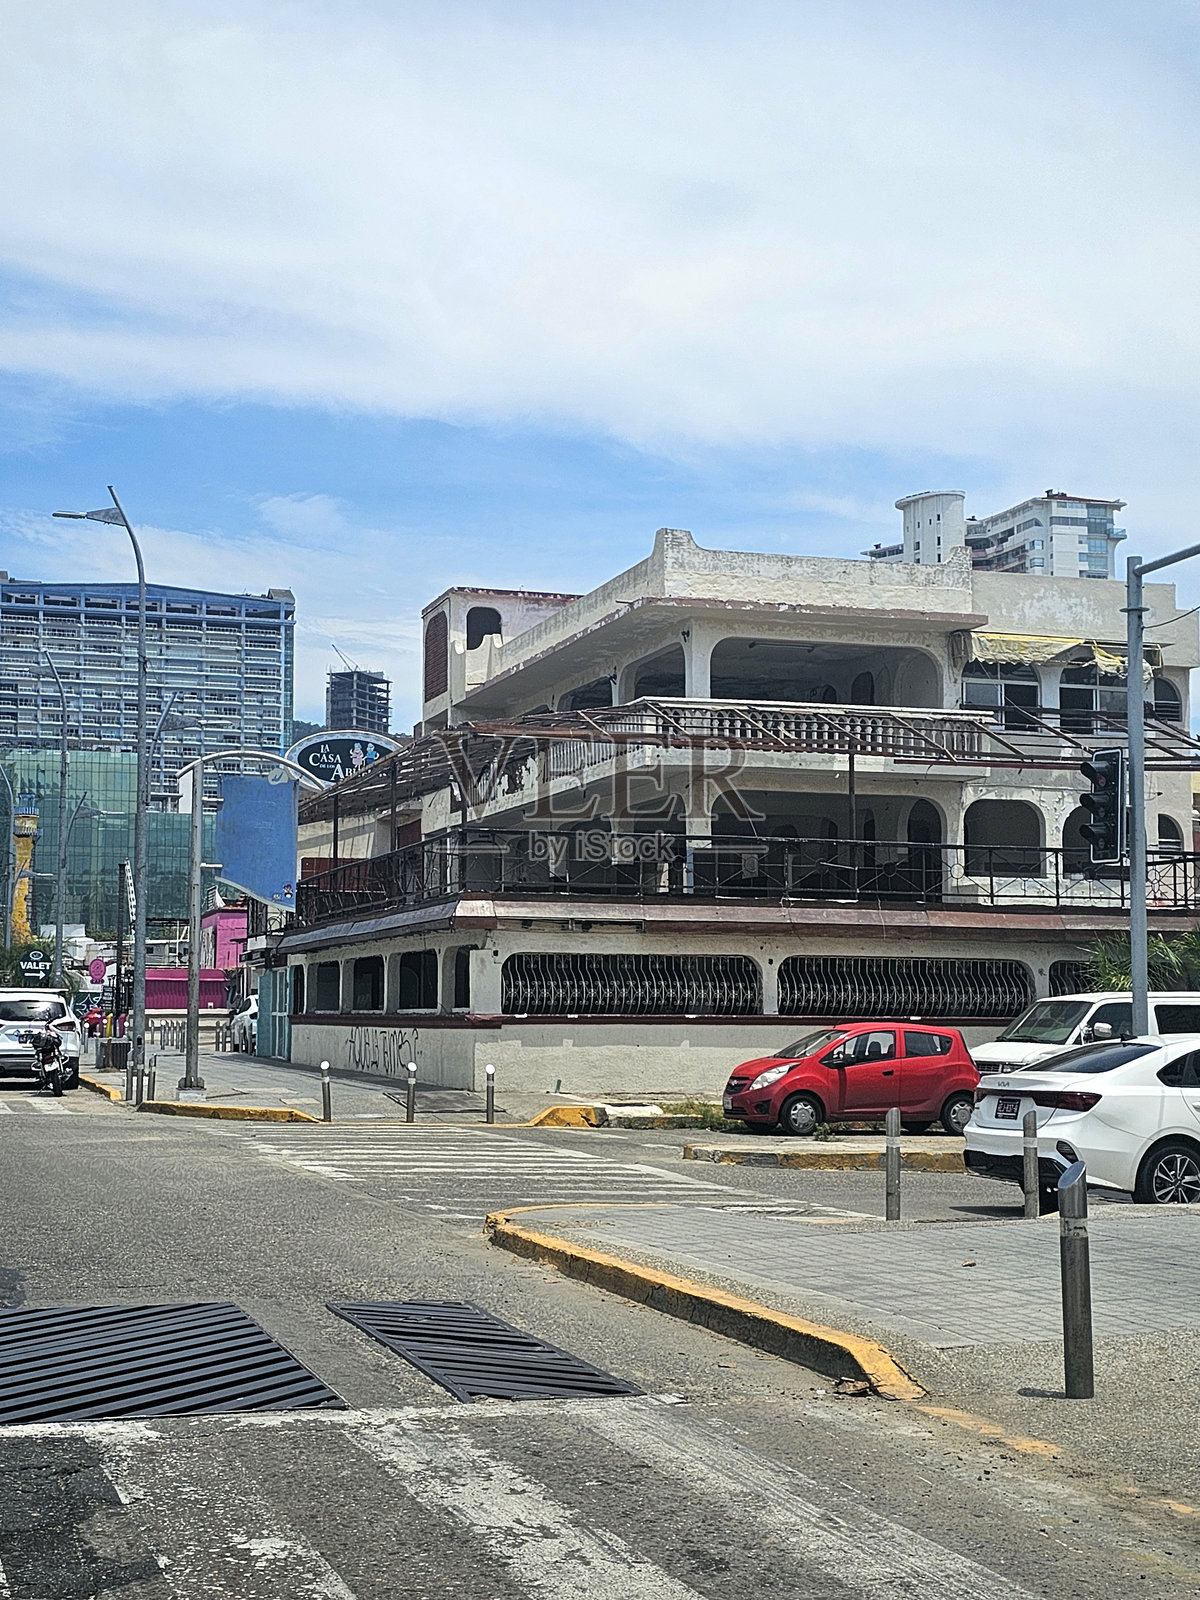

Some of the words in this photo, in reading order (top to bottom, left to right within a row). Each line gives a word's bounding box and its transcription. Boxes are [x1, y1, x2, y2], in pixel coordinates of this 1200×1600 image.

[320, 744, 330, 754] LA
[309, 753, 342, 766] CASA
[20, 962, 52, 970] VALET
